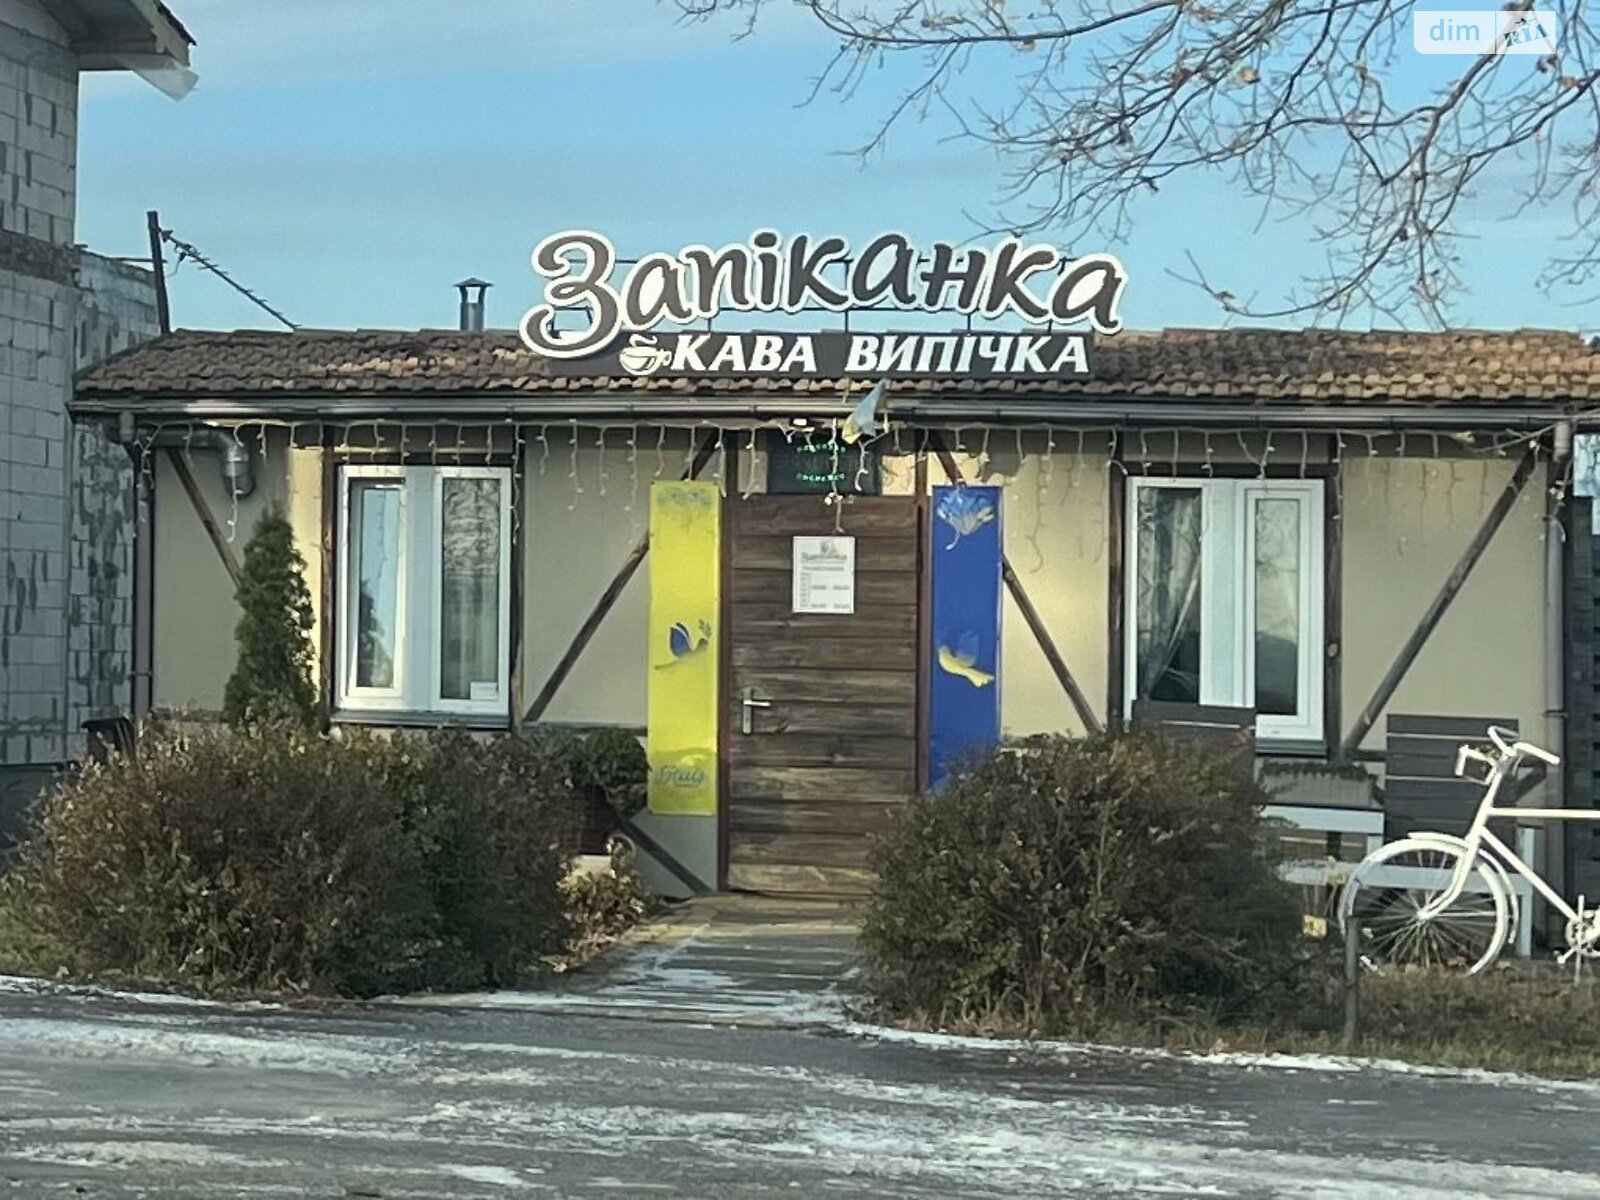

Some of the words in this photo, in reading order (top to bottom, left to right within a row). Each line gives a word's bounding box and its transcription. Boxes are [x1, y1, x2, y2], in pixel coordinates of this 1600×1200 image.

[520, 229, 1127, 359] Запіканка
[670, 335, 817, 372] КАВА
[844, 335, 1090, 373] ВИПІЧКА
